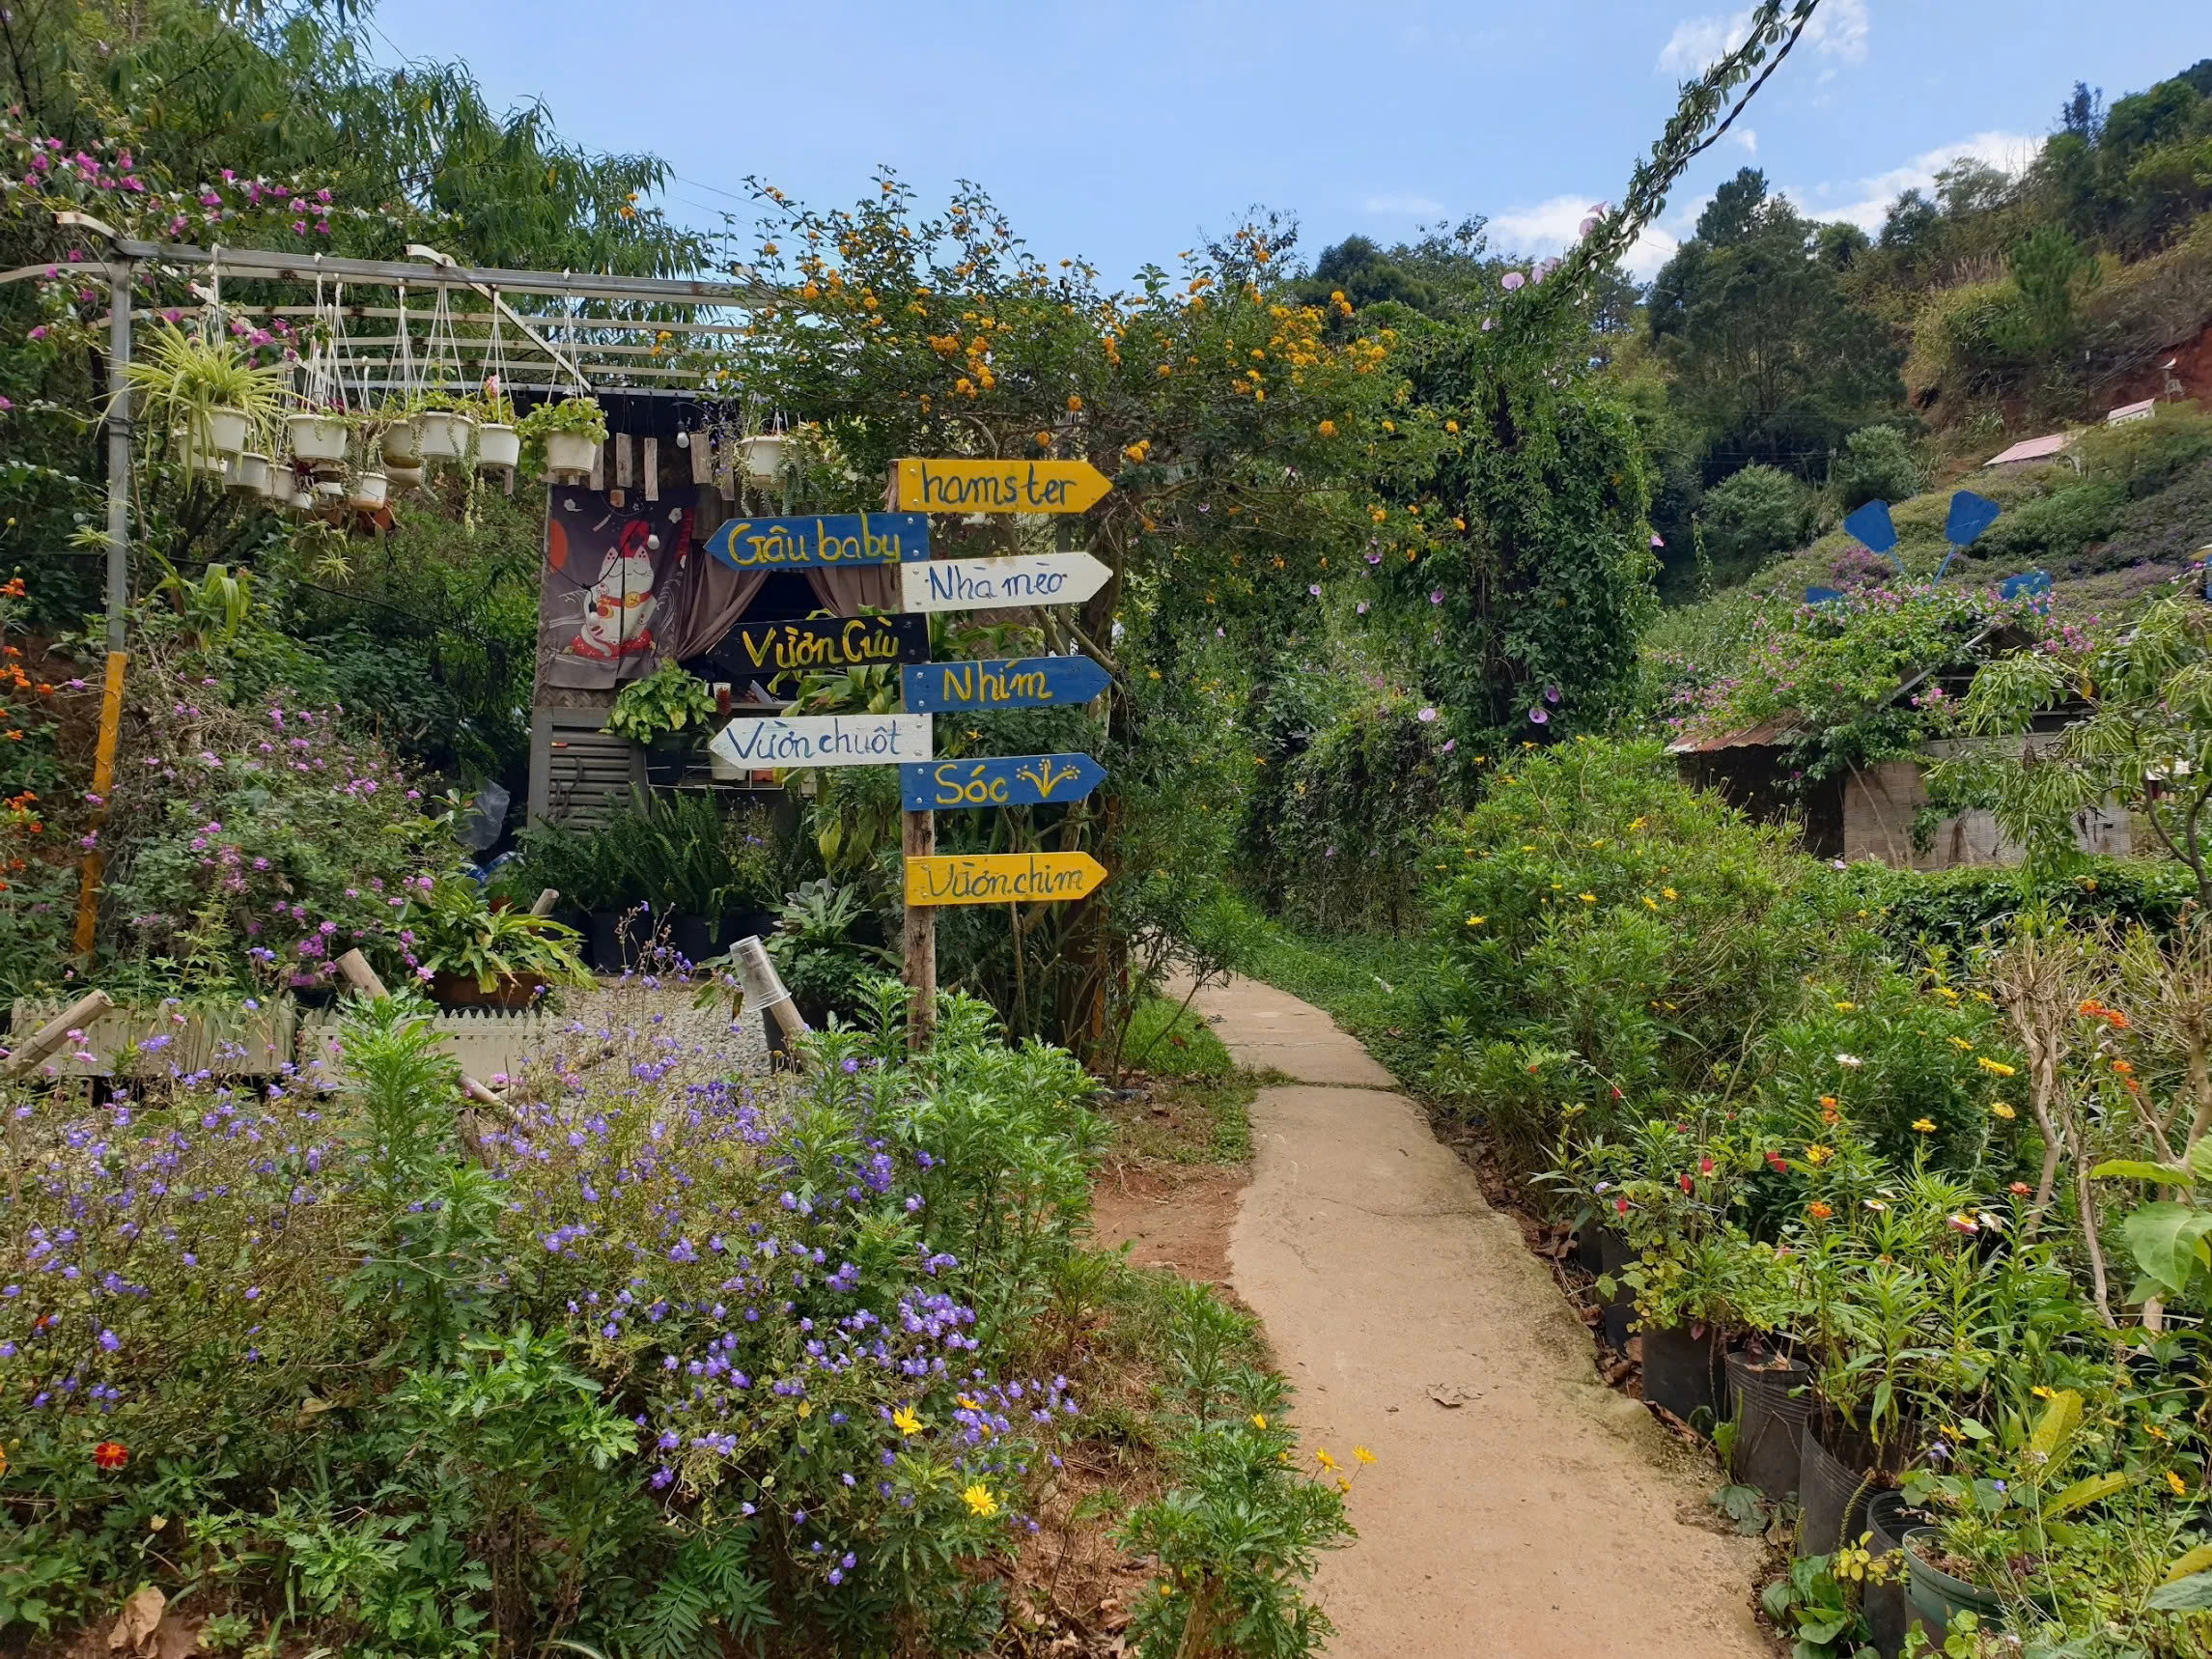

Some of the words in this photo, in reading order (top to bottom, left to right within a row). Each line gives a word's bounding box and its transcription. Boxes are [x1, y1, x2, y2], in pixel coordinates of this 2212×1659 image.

[921, 462, 1078, 505] hamster
[817, 510, 901, 564] baby
[943, 659, 1054, 703] Nhím
[934, 764, 1009, 805] Sóc
[1014, 855, 1083, 894] chim
